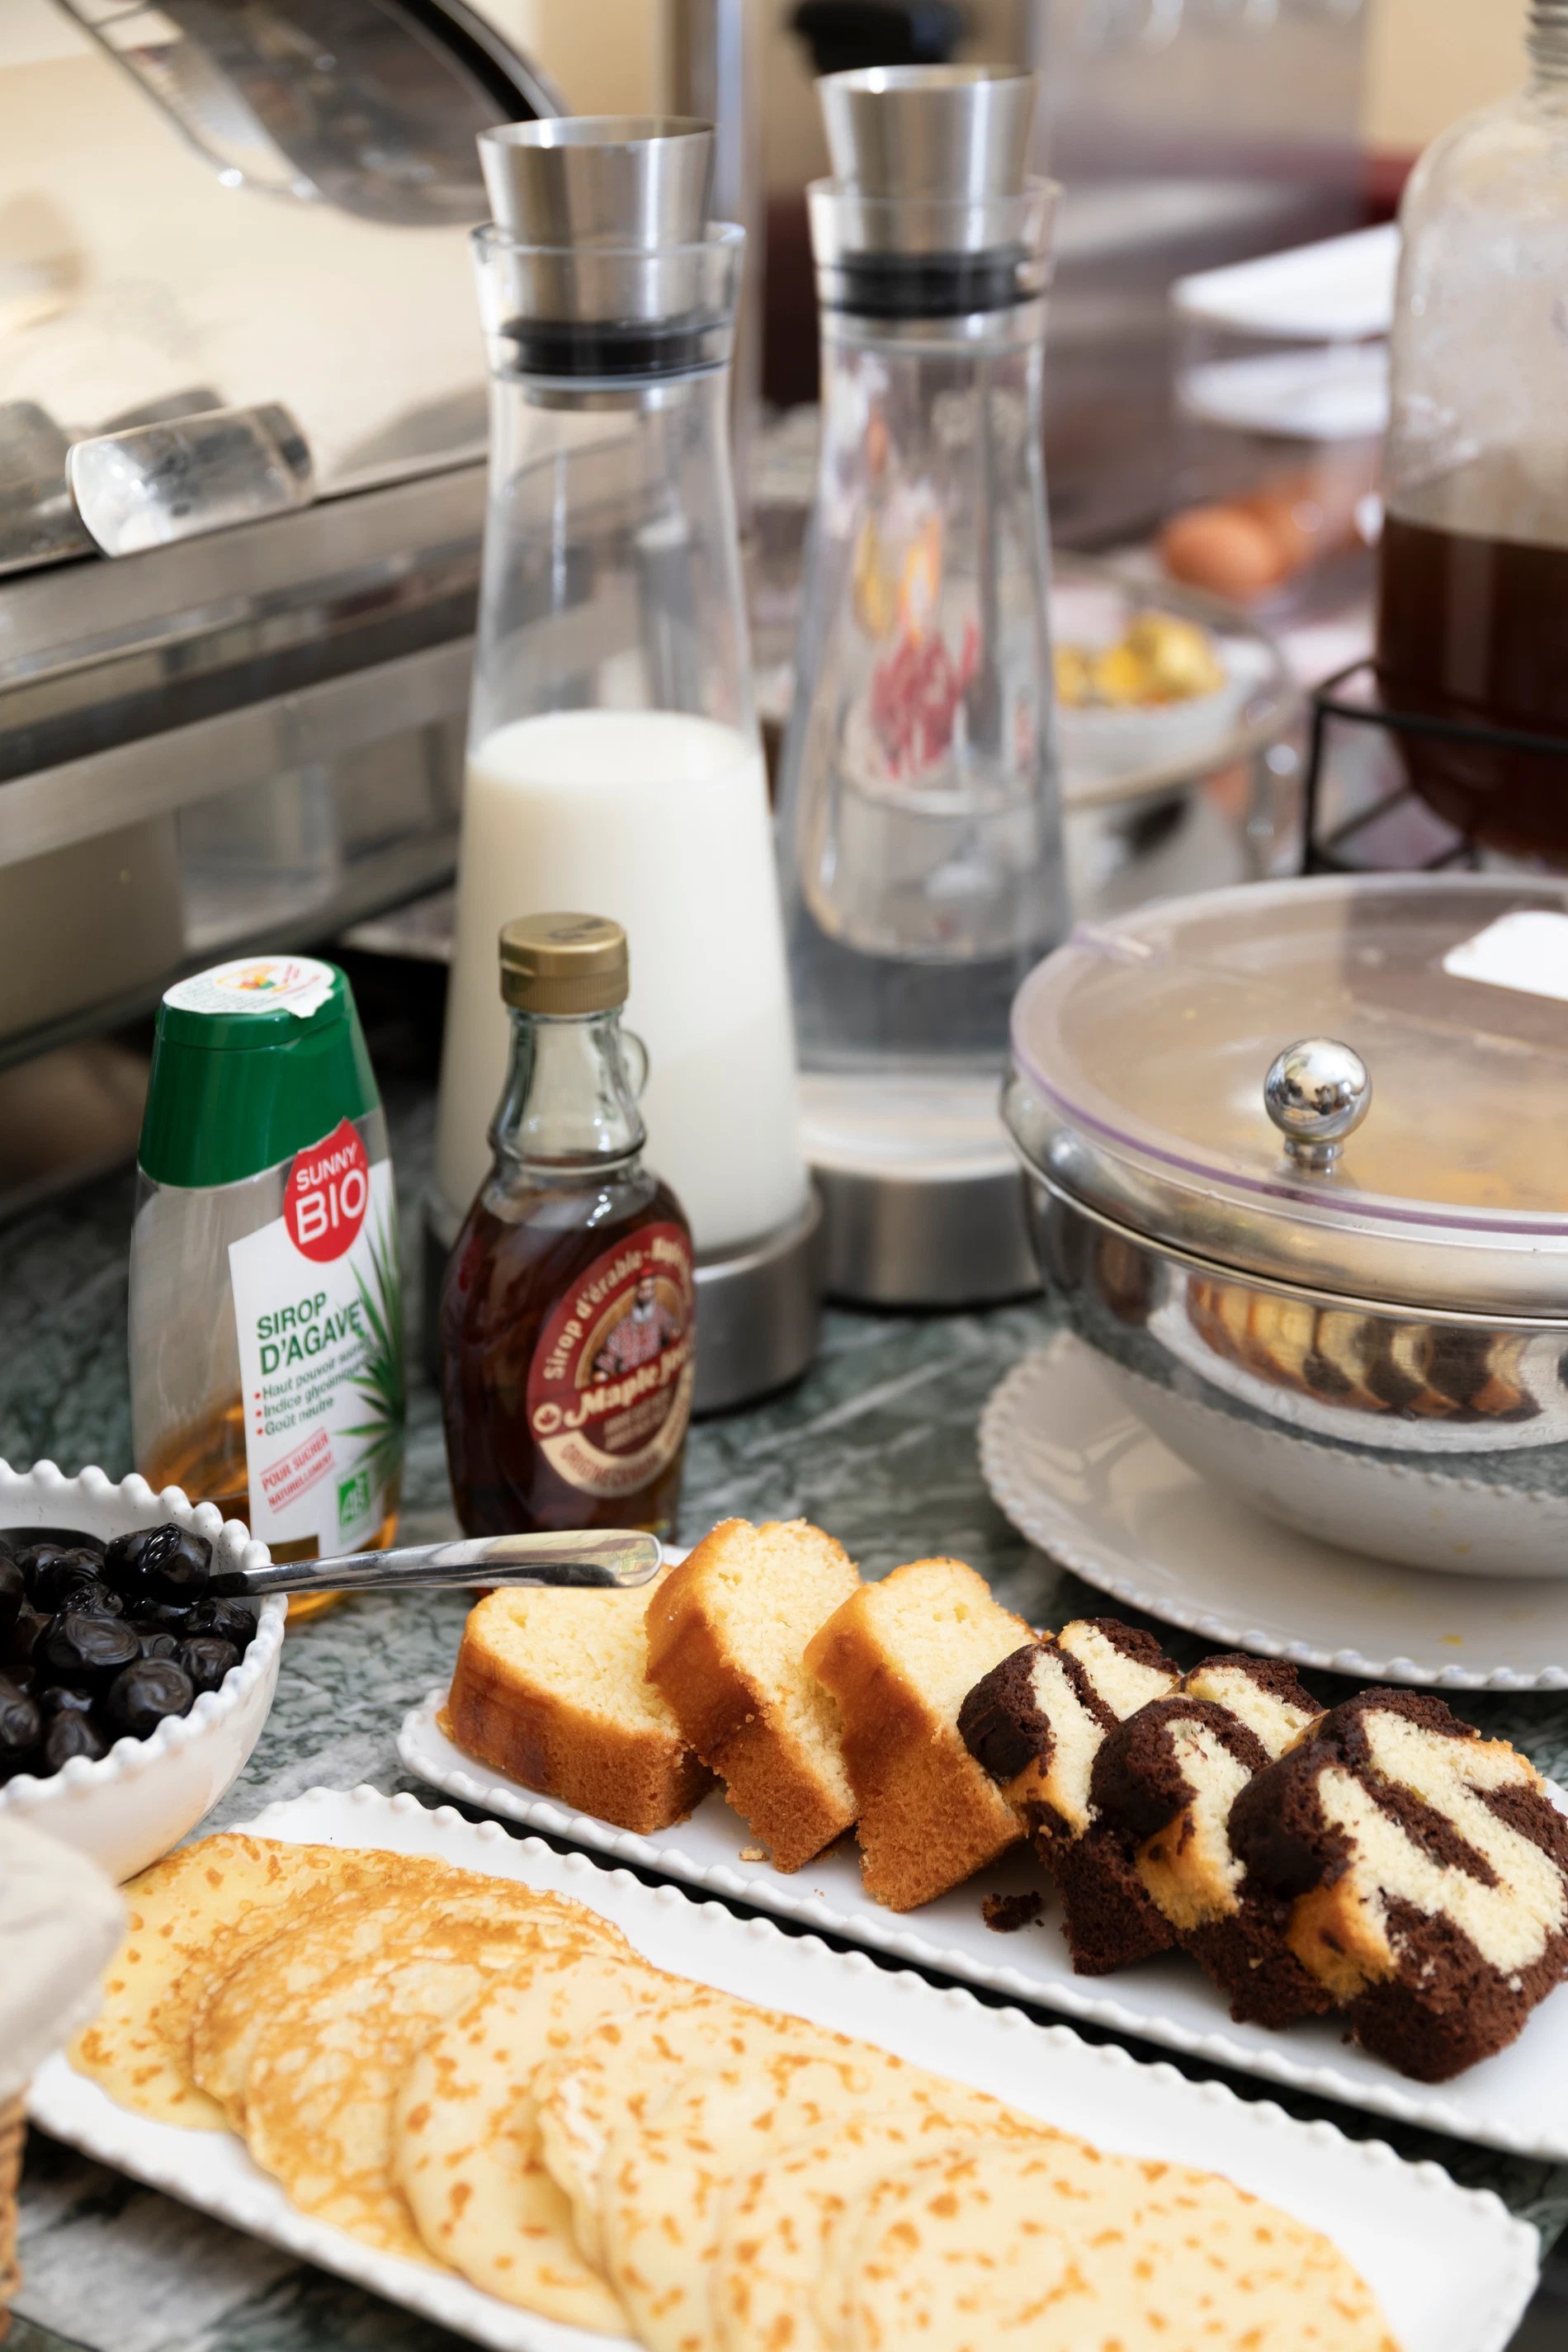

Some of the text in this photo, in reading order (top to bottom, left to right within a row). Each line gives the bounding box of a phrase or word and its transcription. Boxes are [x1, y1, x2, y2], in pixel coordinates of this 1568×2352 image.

[296, 1142, 357, 1192] SUNNY
[296, 1169, 366, 1244] BIO
[257, 1292, 326, 1341] SIROP
[260, 1298, 361, 1376] D'AGAVE
[544, 1318, 584, 1381] Sirop
[262, 1376, 294, 1401] Haut
[296, 1356, 337, 1387] pouvoir
[564, 1363, 659, 1429] Maple
[263, 1395, 302, 1419] Indice
[265, 1397, 334, 1437] Goût neutre
[262, 1432, 329, 1492] POUR SUCRER
